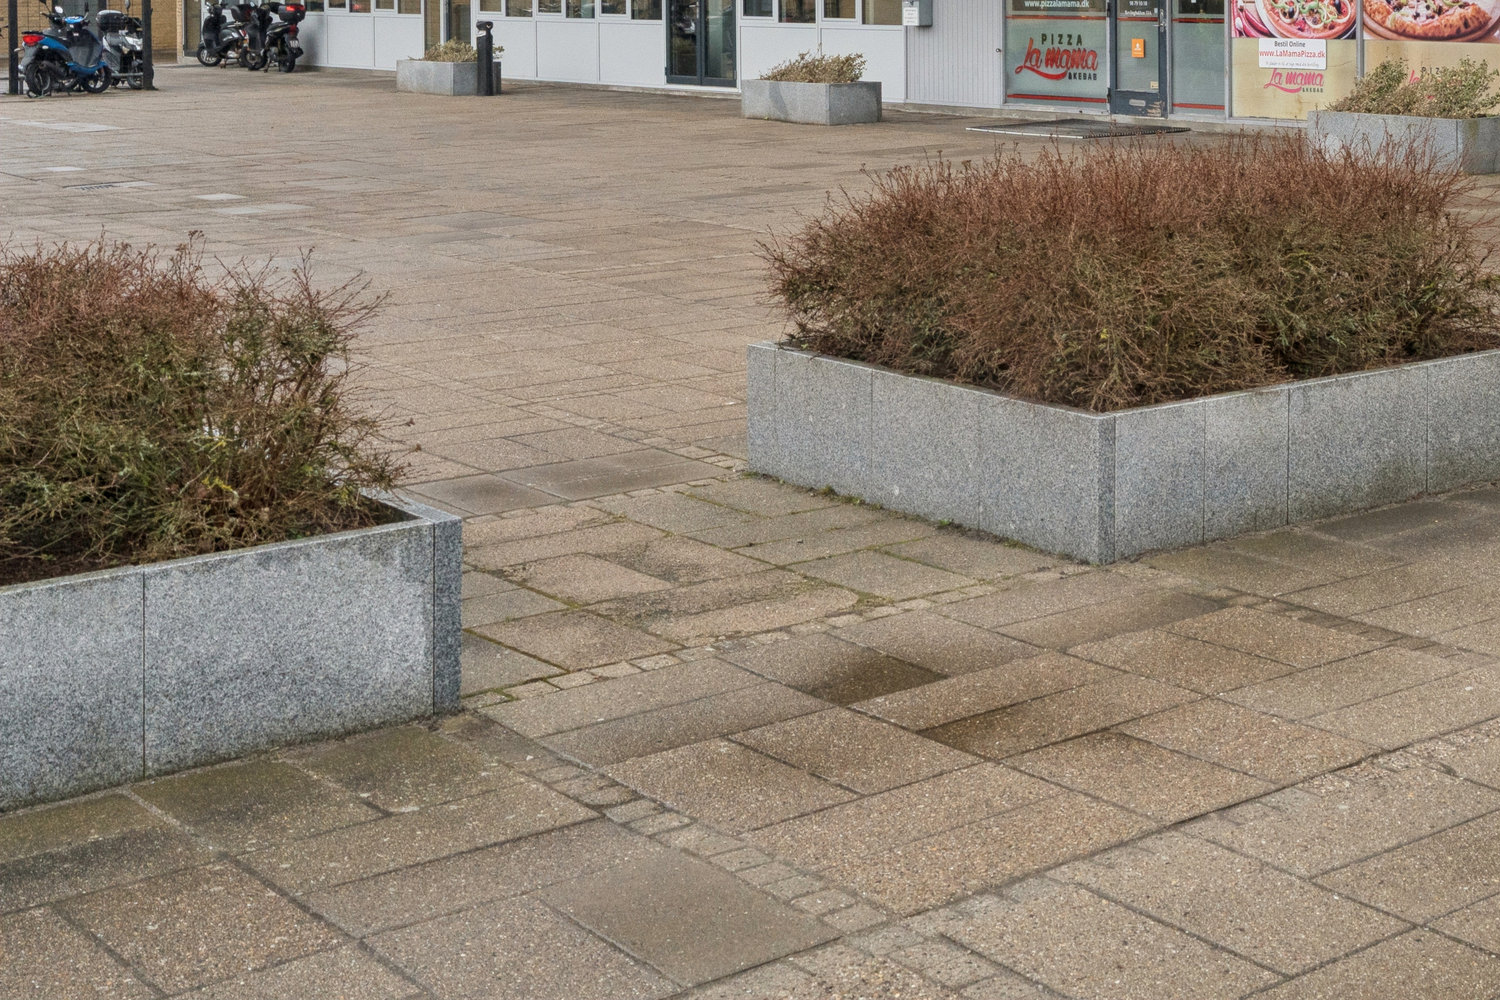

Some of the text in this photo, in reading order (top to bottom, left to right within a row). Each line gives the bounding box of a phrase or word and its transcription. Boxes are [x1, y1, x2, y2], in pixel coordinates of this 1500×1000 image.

[1024, 0, 1089, 9] www.pizzalamama.dk
[1041, 33, 1083, 46] PIZZA
[1045, 47, 1098, 71] mama
[1259, 50, 1326, 58] www.LaMamaPizza.dk
[1285, 71, 1325, 87] mama
